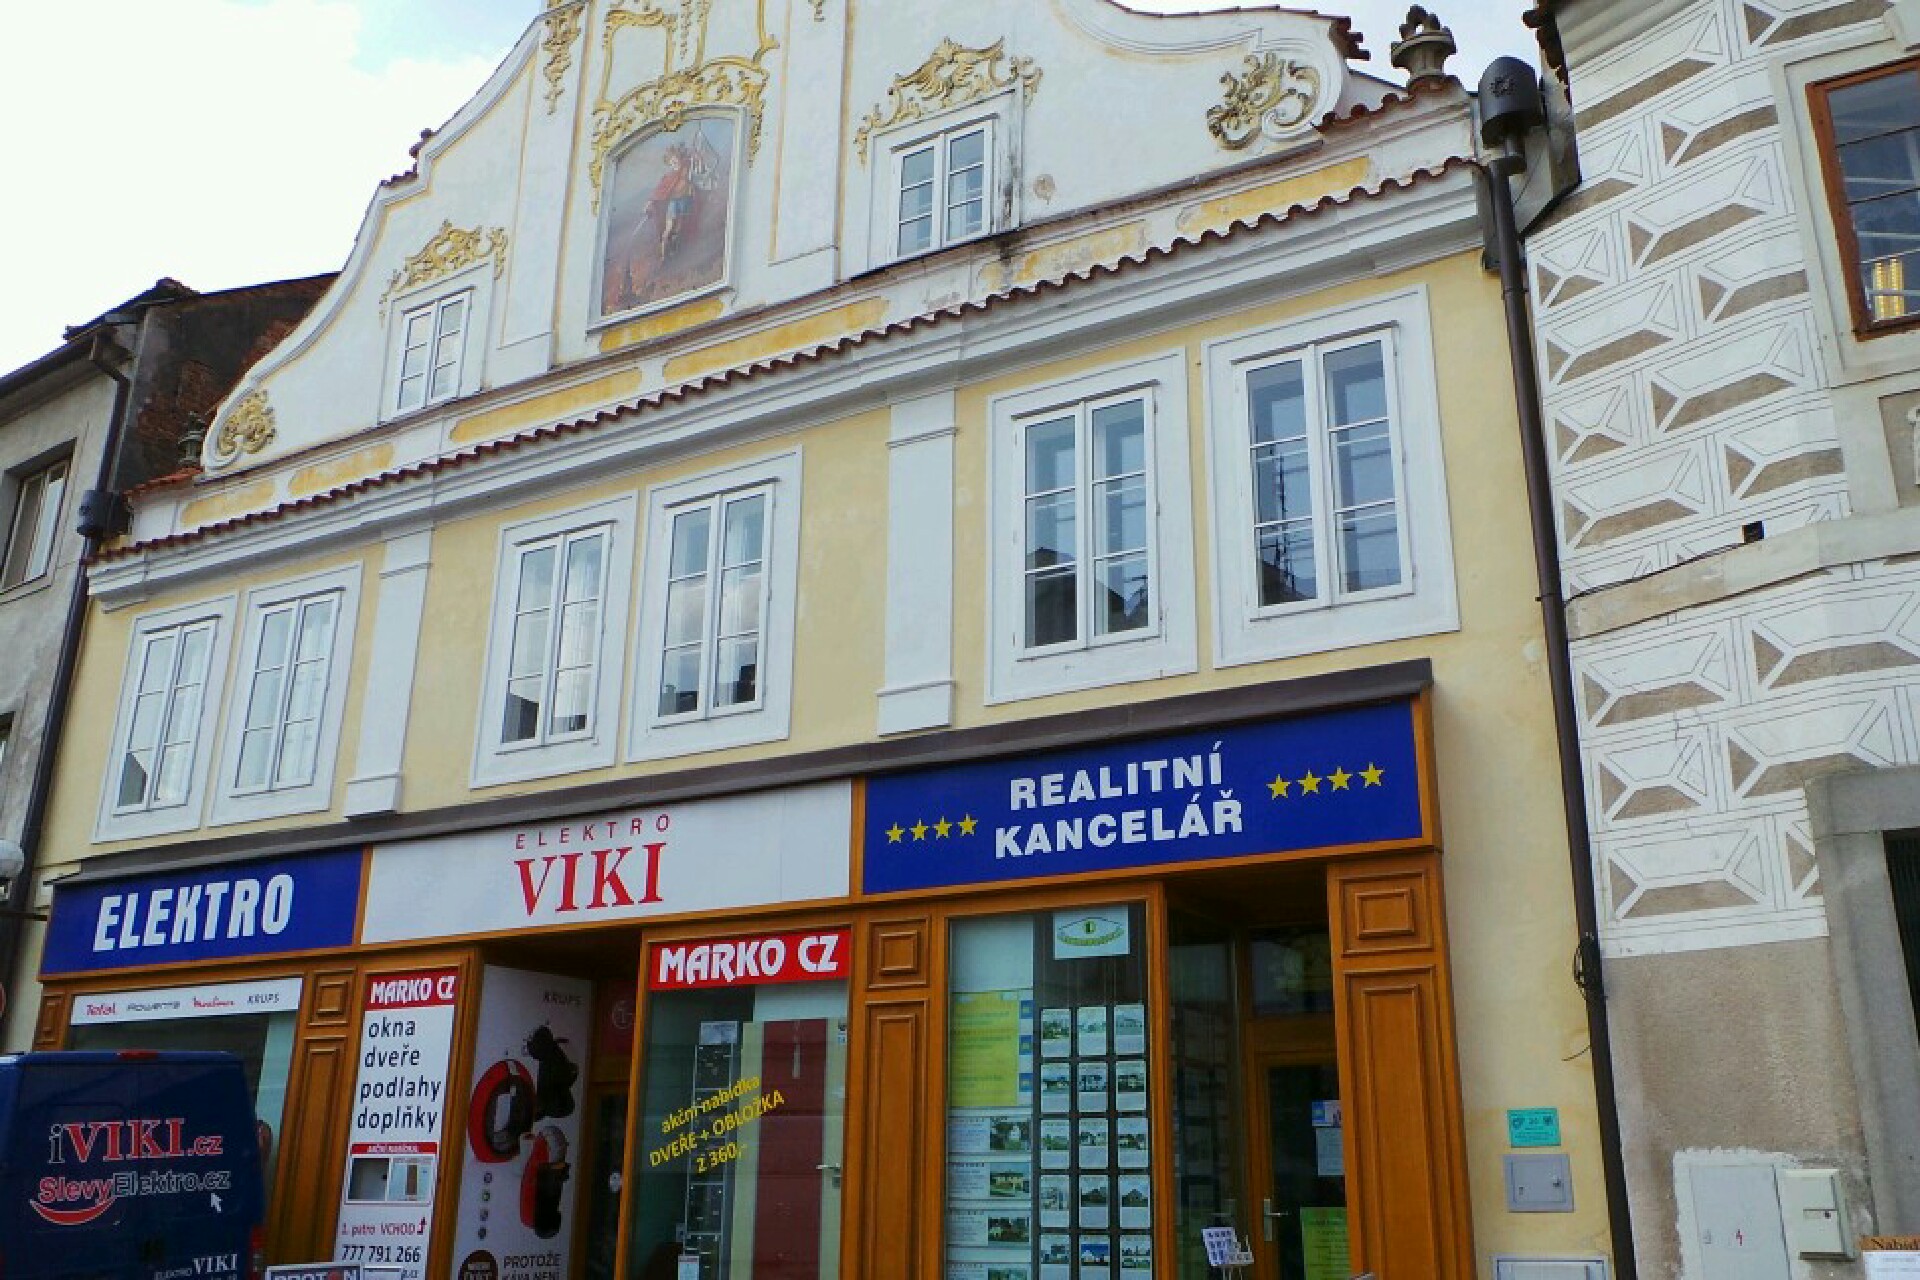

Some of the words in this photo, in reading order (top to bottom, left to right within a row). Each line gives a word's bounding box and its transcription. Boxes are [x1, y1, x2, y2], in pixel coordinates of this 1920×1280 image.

[1010, 741, 1222, 810] REALITNÍ
[515, 813, 671, 849] ELEKTRO
[995, 788, 1243, 858] KANCELÁŘ
[513, 843, 667, 916] VIKI
[92, 873, 295, 952] ELEKTRO
[659, 939, 787, 984] MARKO
[797, 934, 839, 973] CZ
[370, 977, 432, 1005] MARKO
[436, 975, 456, 1000] CZ
[368, 1016, 416, 1038] okna
[364, 1043, 421, 1068] dveře
[360, 1074, 442, 1104] podlahy
[357, 1105, 438, 1134] doplňky
[193, 1253, 238, 1274] VIKI
[341, 1245, 366, 1262] 777
[368, 1245, 392, 1263] 791
[395, 1245, 422, 1263] 266
